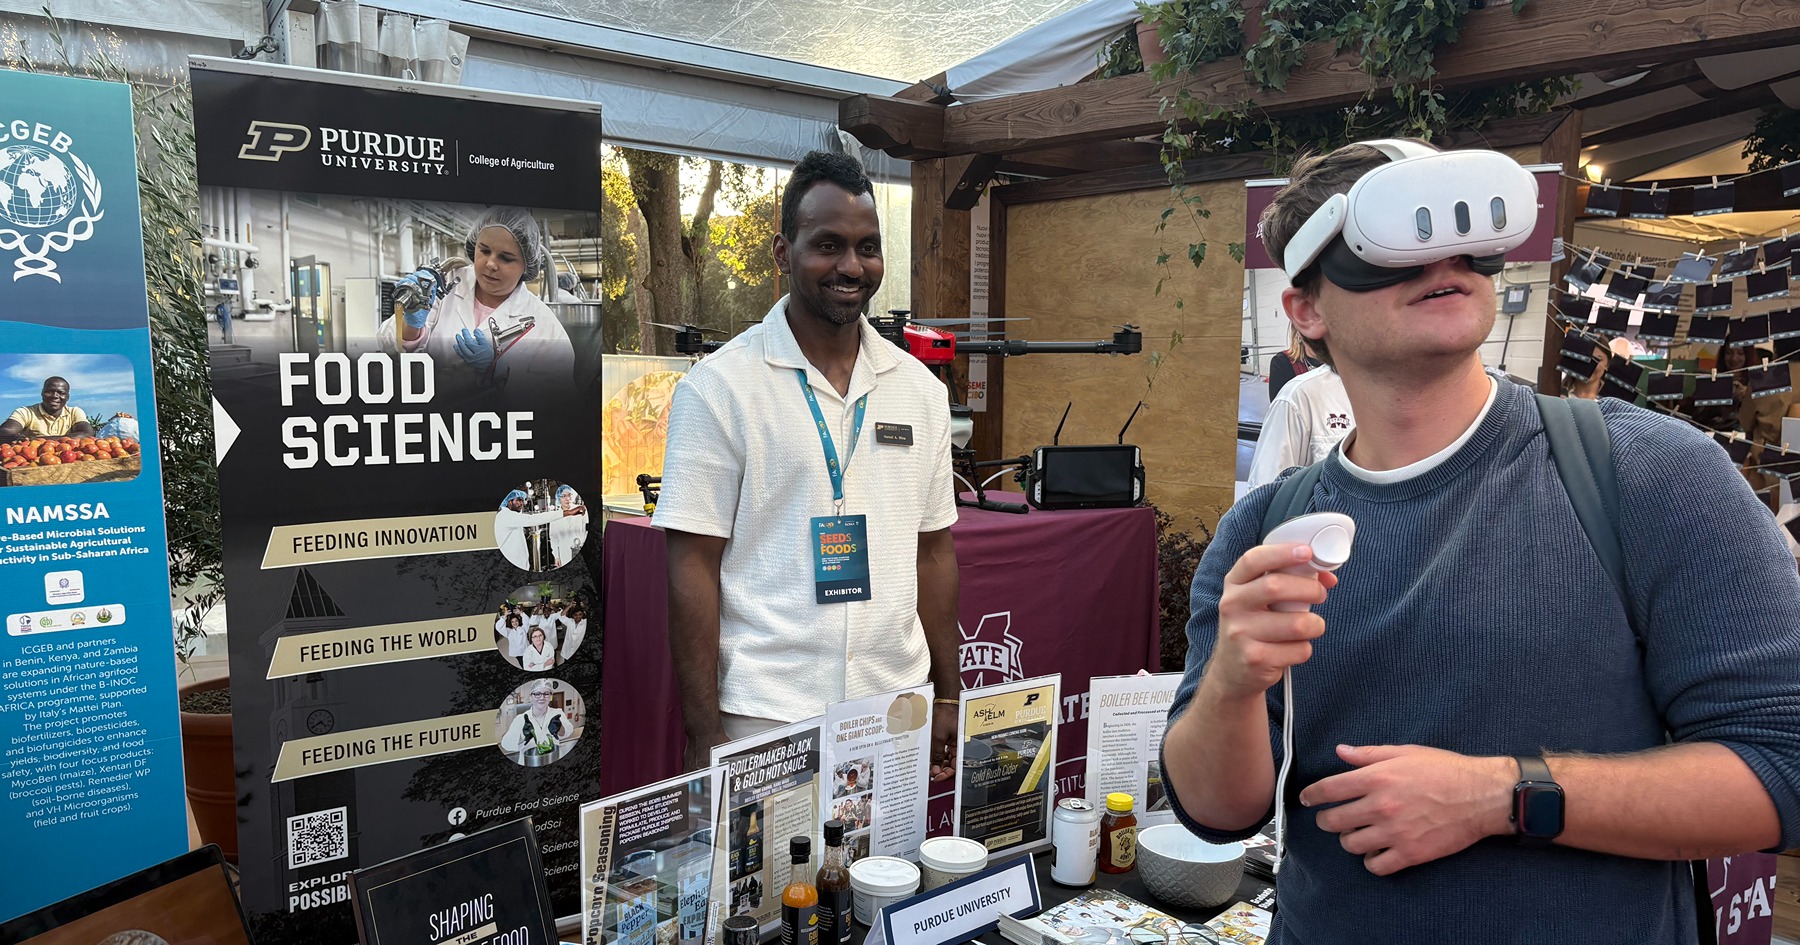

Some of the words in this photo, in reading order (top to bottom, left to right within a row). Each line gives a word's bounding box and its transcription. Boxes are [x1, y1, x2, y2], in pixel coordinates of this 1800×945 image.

[320, 126, 445, 161] PURDUE
[321, 154, 445, 175] UNIVERSITY
[469, 154, 500, 167] College
[501, 156, 510, 167] of
[510, 157, 555, 172] Agriculture
[279, 352, 436, 406] FOOD
[281, 411, 536, 470] SCIENCE
[6, 502, 110, 525] NAMSSA
[0, 531, 44, 542] e-Based
[46, 527, 96, 539] Microbial
[97, 524, 146, 537] Solutions
[5, 538, 68, 553] Sustainable
[69, 536, 132, 550] Agricultural
[292, 530, 369, 554] FEEDING
[374, 523, 478, 549] INNOVATION
[820, 532, 852, 545] SEEDS
[39, 553, 50, 562] in
[51, 548, 118, 561] Sub-Saharan
[119, 545, 149, 556] Africa
[821, 543, 857, 556] FOODS
[824, 587, 863, 597] EXHIBITOR
[14, 657, 46, 667] Benin,
[48, 653, 80, 664] Kenya,
[83, 649, 101, 659] and
[103, 646, 138, 656] Zambia
[21, 643, 54, 655] ICGEB
[56, 641, 75, 651] and
[77, 638, 117, 650] partners
[299, 637, 375, 663] FEEDING
[379, 633, 413, 656] THE
[417, 626, 478, 649] WORLD
[2, 671, 18, 680] are
[20, 665, 72, 677] expanding
[74, 655, 138, 670] nature-based
[3, 679, 49, 691] solutions
[62, 672, 97, 683] African
[99, 666, 138, 679] agrifood
[0, 701, 35, 712] AFRICA
[37, 694, 97, 709] programme,
[99, 685, 147, 699] supported
[7, 690, 47, 702] systems
[49, 686, 78, 695] under
[80, 683, 97, 691] the
[99, 676, 136, 689] B-INOC
[1100, 693, 1132, 708] BOILER
[1132, 691, 1150, 706] BEE
[1149, 689, 1175, 705] HONE
[22, 723, 42, 731] The
[44, 717, 79, 730] project
[81, 711, 128, 725] promotes
[24, 713, 37, 722] by
[69, 704, 99, 714] Mattei
[101, 701, 124, 709] Plan.
[839, 719, 859, 732] BOILER
[859, 715, 875, 728] CHIPS
[1015, 705, 1046, 720] PURDUE
[5, 746, 24, 756] and
[27, 737, 92, 753] biofungicides
[106, 729, 147, 741] enhance
[11, 730, 73, 744] biofertilizers,
[76, 720, 140, 734] biopesticides,
[836, 731, 848, 744] ONE
[847, 728, 865, 741] GIANT
[864, 724, 885, 737] SCOOP:
[10, 756, 41, 768] yields,
[43, 747, 100, 761] biodiversity,
[102, 742, 120, 752] and
[122, 738, 144, 748] food
[301, 739, 376, 767] FEEDING
[381, 731, 414, 754] THE
[418, 723, 482, 747] FUTURE
[729, 745, 786, 778] BOILERMAKER
[786, 737, 813, 759] BLACK
[1, 769, 33, 779] safety,
[35, 764, 57, 774] with
[59, 761, 79, 769] four
[81, 756, 108, 765] focus
[110, 748, 154, 762] products:
[11, 775, 57, 788] MycoBen
[60, 767, 97, 781] (maize),
[99, 762, 132, 773] Xentari
[134, 758, 146, 767] DF
[734, 776, 742, 792] &
[742, 768, 765, 789] GOLD
[765, 762, 783, 782] HOT
[782, 753, 808, 776] SAUCE
[971, 769, 987, 784] Gold
[986, 765, 1002, 780] Rush
[1001, 763, 1019, 776] Cider
[9, 786, 53, 800] (broccoli
[55, 780, 85, 793] pests),
[88, 773, 133, 786] Remedier
[135, 768, 151, 777] WP
[32, 792, 85, 807] (soil-borne
[87, 782, 131, 797] diseases),
[26, 808, 44, 818] and
[46, 805, 61, 814] VH
[64, 792, 139, 811] Microorganisms
[33, 816, 57, 828] (field
[59, 813, 78, 823] and
[80, 810, 99, 819] fruit
[101, 803, 133, 815] crops).
[475, 806, 512, 820] Purdue
[514, 798, 541, 812] Food
[541, 792, 580, 807] Science
[670, 808, 681, 816] AND
[541, 839, 579, 854] Science
[592, 804, 616, 883] Seasoning
[289, 869, 353, 893] EXPLOR
[543, 861, 579, 877] Science
[289, 883, 352, 914] POSSIBI
[913, 910, 953, 935] PURDUE
[955, 886, 1012, 918] UNIVERSITY
[429, 893, 494, 941] SHAPING
[586, 885, 604, 945] Popcorn
[621, 908, 650, 934] Pepper
[624, 902, 645, 921] BLACK
[455, 932, 478, 945] THE
[493, 926, 529, 945] OOD
